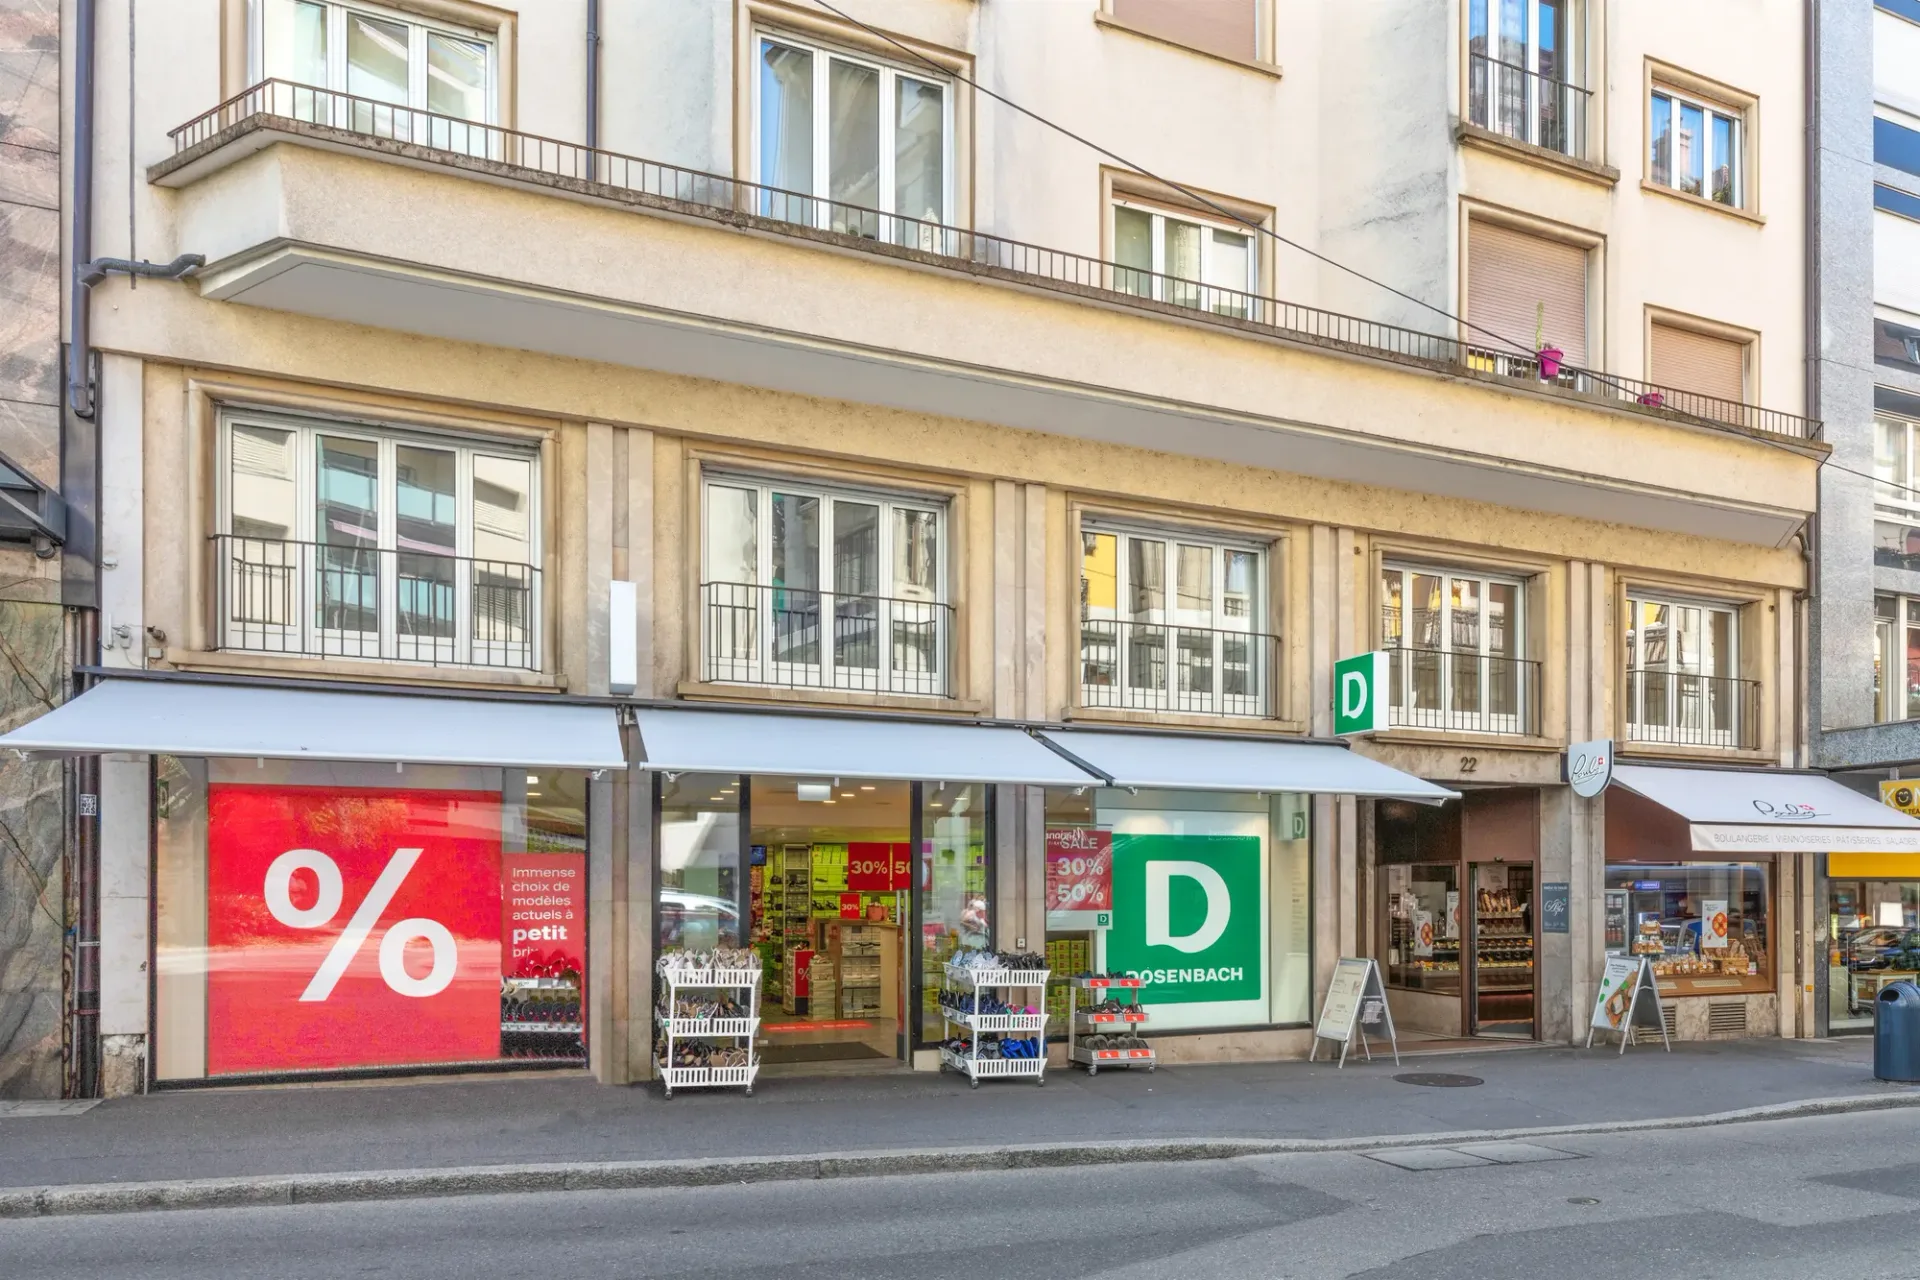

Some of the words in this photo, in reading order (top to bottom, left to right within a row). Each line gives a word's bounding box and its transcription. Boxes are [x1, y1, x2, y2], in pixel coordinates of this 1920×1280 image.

[1342, 671, 1367, 719] D
[1460, 756, 1477, 773] 22
[1060, 837, 1098, 849] SALE
[1714, 833, 1769, 844] BOULANGERIE
[1775, 834, 1831, 844] VIENNOISERIES
[1886, 836, 1917, 846] SALADES
[512, 867, 576, 878] Immense
[851, 860, 888, 875] 30%
[1057, 857, 1104, 876] 30%
[512, 881, 550, 892] choix
[553, 881, 570, 892] de
[1057, 883, 1104, 904] 50%
[512, 895, 571, 906] modèles
[842, 903, 859, 911] 30%
[1145, 860, 1231, 953] D
[512, 909, 562, 920] actuels
[565, 909, 574, 919] à
[263, 847, 458, 1002] %
[513, 925, 568, 945] petit
[513, 946, 539, 958] pri
